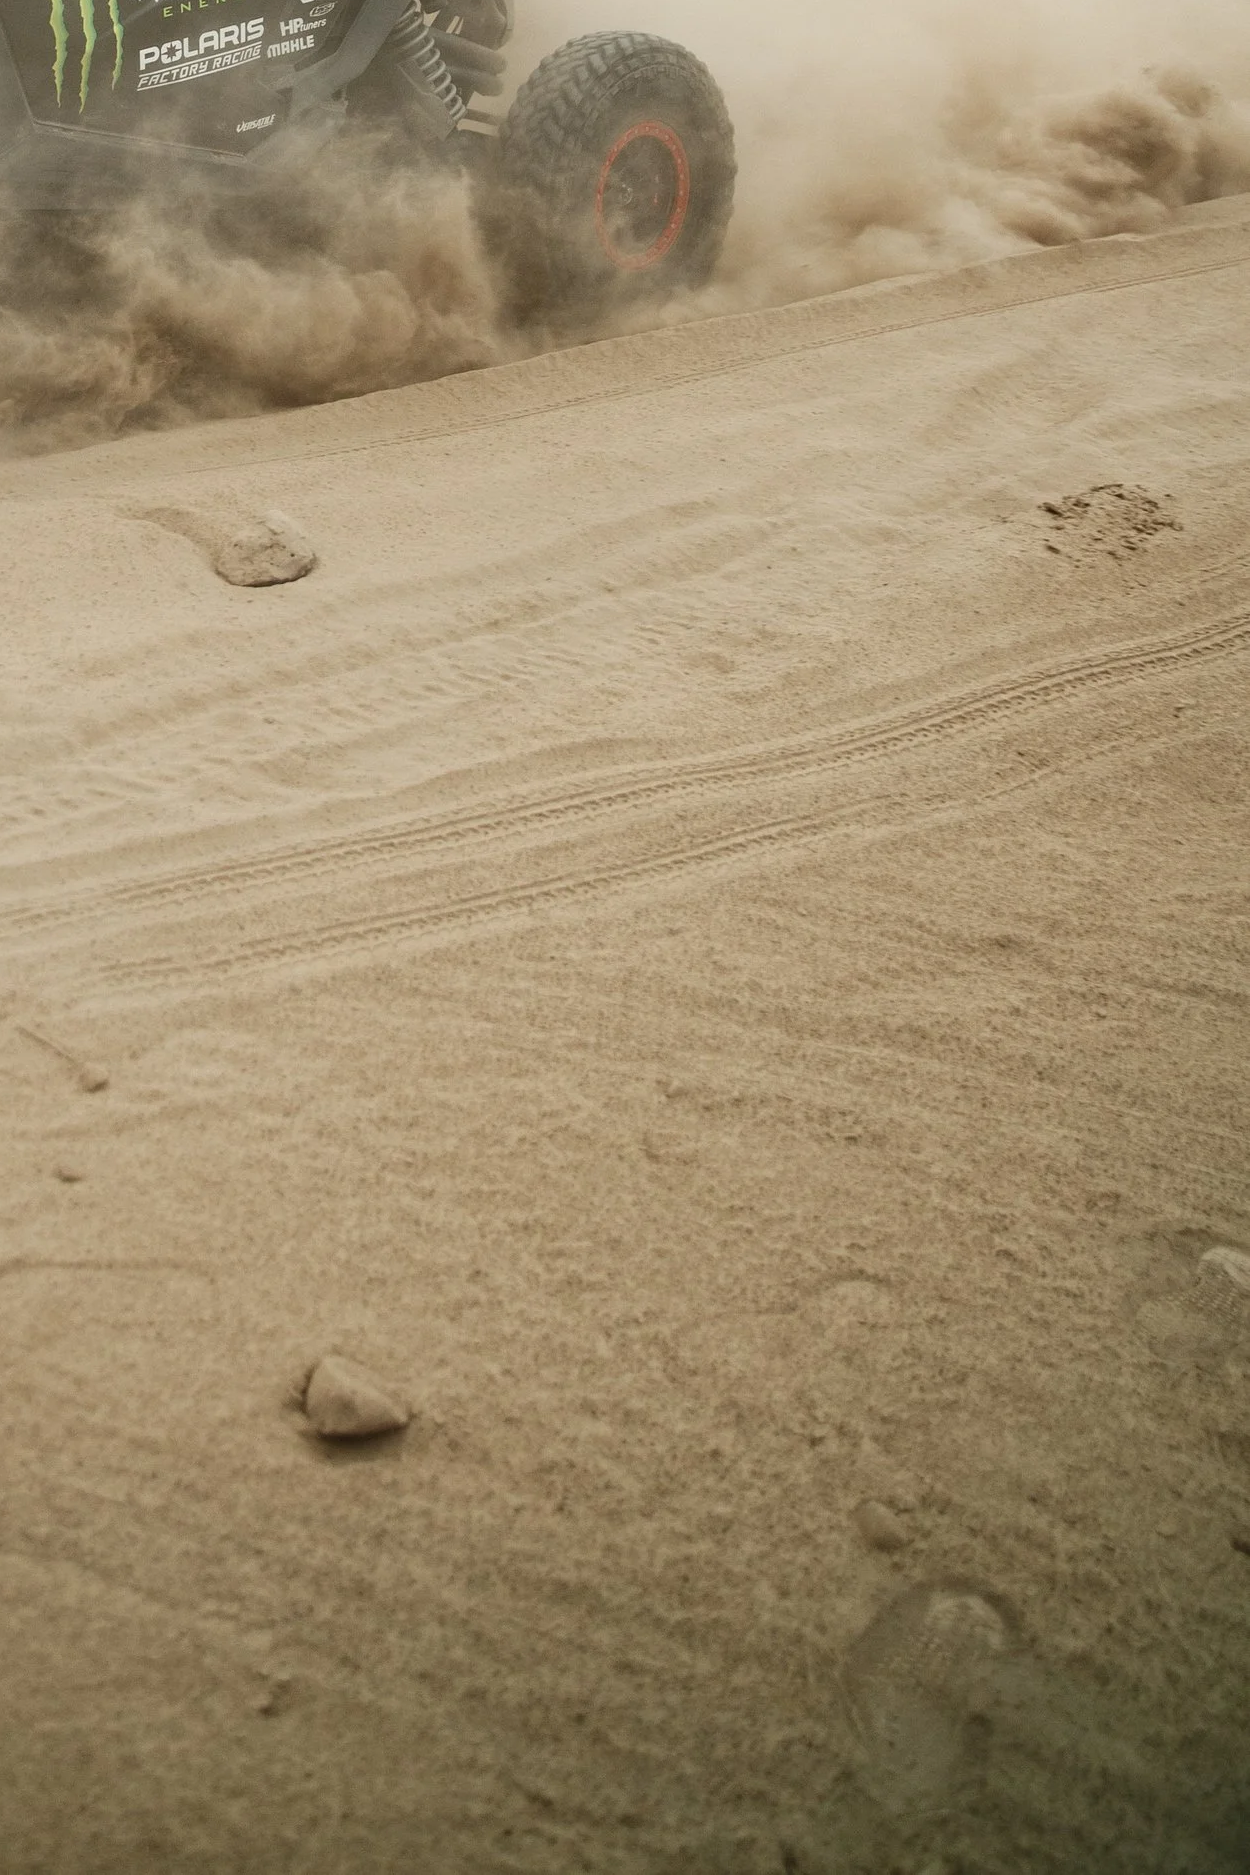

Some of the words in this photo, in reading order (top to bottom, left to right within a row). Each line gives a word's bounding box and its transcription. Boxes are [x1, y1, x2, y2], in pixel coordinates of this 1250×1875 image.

[139, 17, 265, 71] POLARIS
[267, 35, 315, 58] MAHLE
[137, 60, 209, 88] FACTORY
[212, 45, 262, 69] RACING
